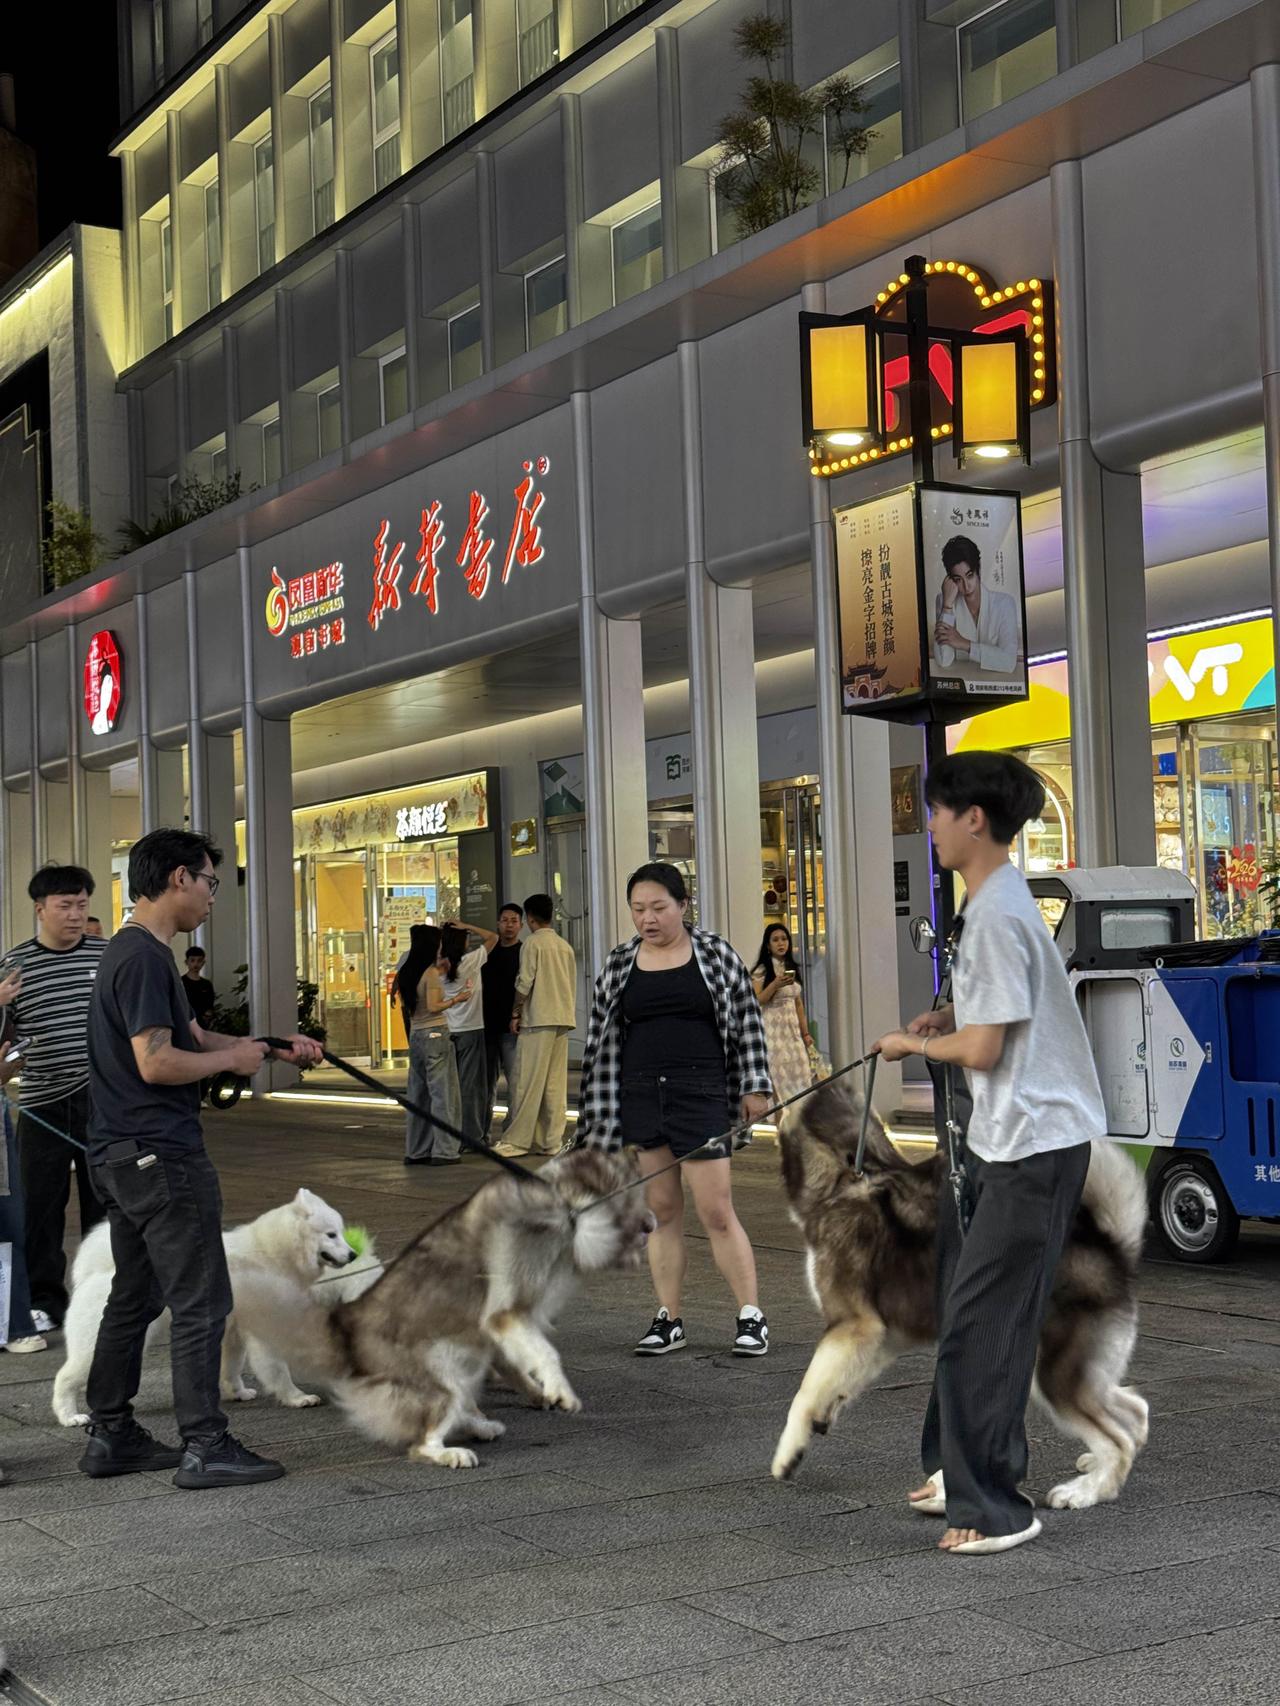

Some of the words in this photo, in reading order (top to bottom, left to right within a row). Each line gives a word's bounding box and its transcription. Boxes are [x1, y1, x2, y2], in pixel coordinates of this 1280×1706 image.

[861, 548, 878, 660] 擦亮金字招牌
[879, 543, 896, 656] 扮靓古城容颜
